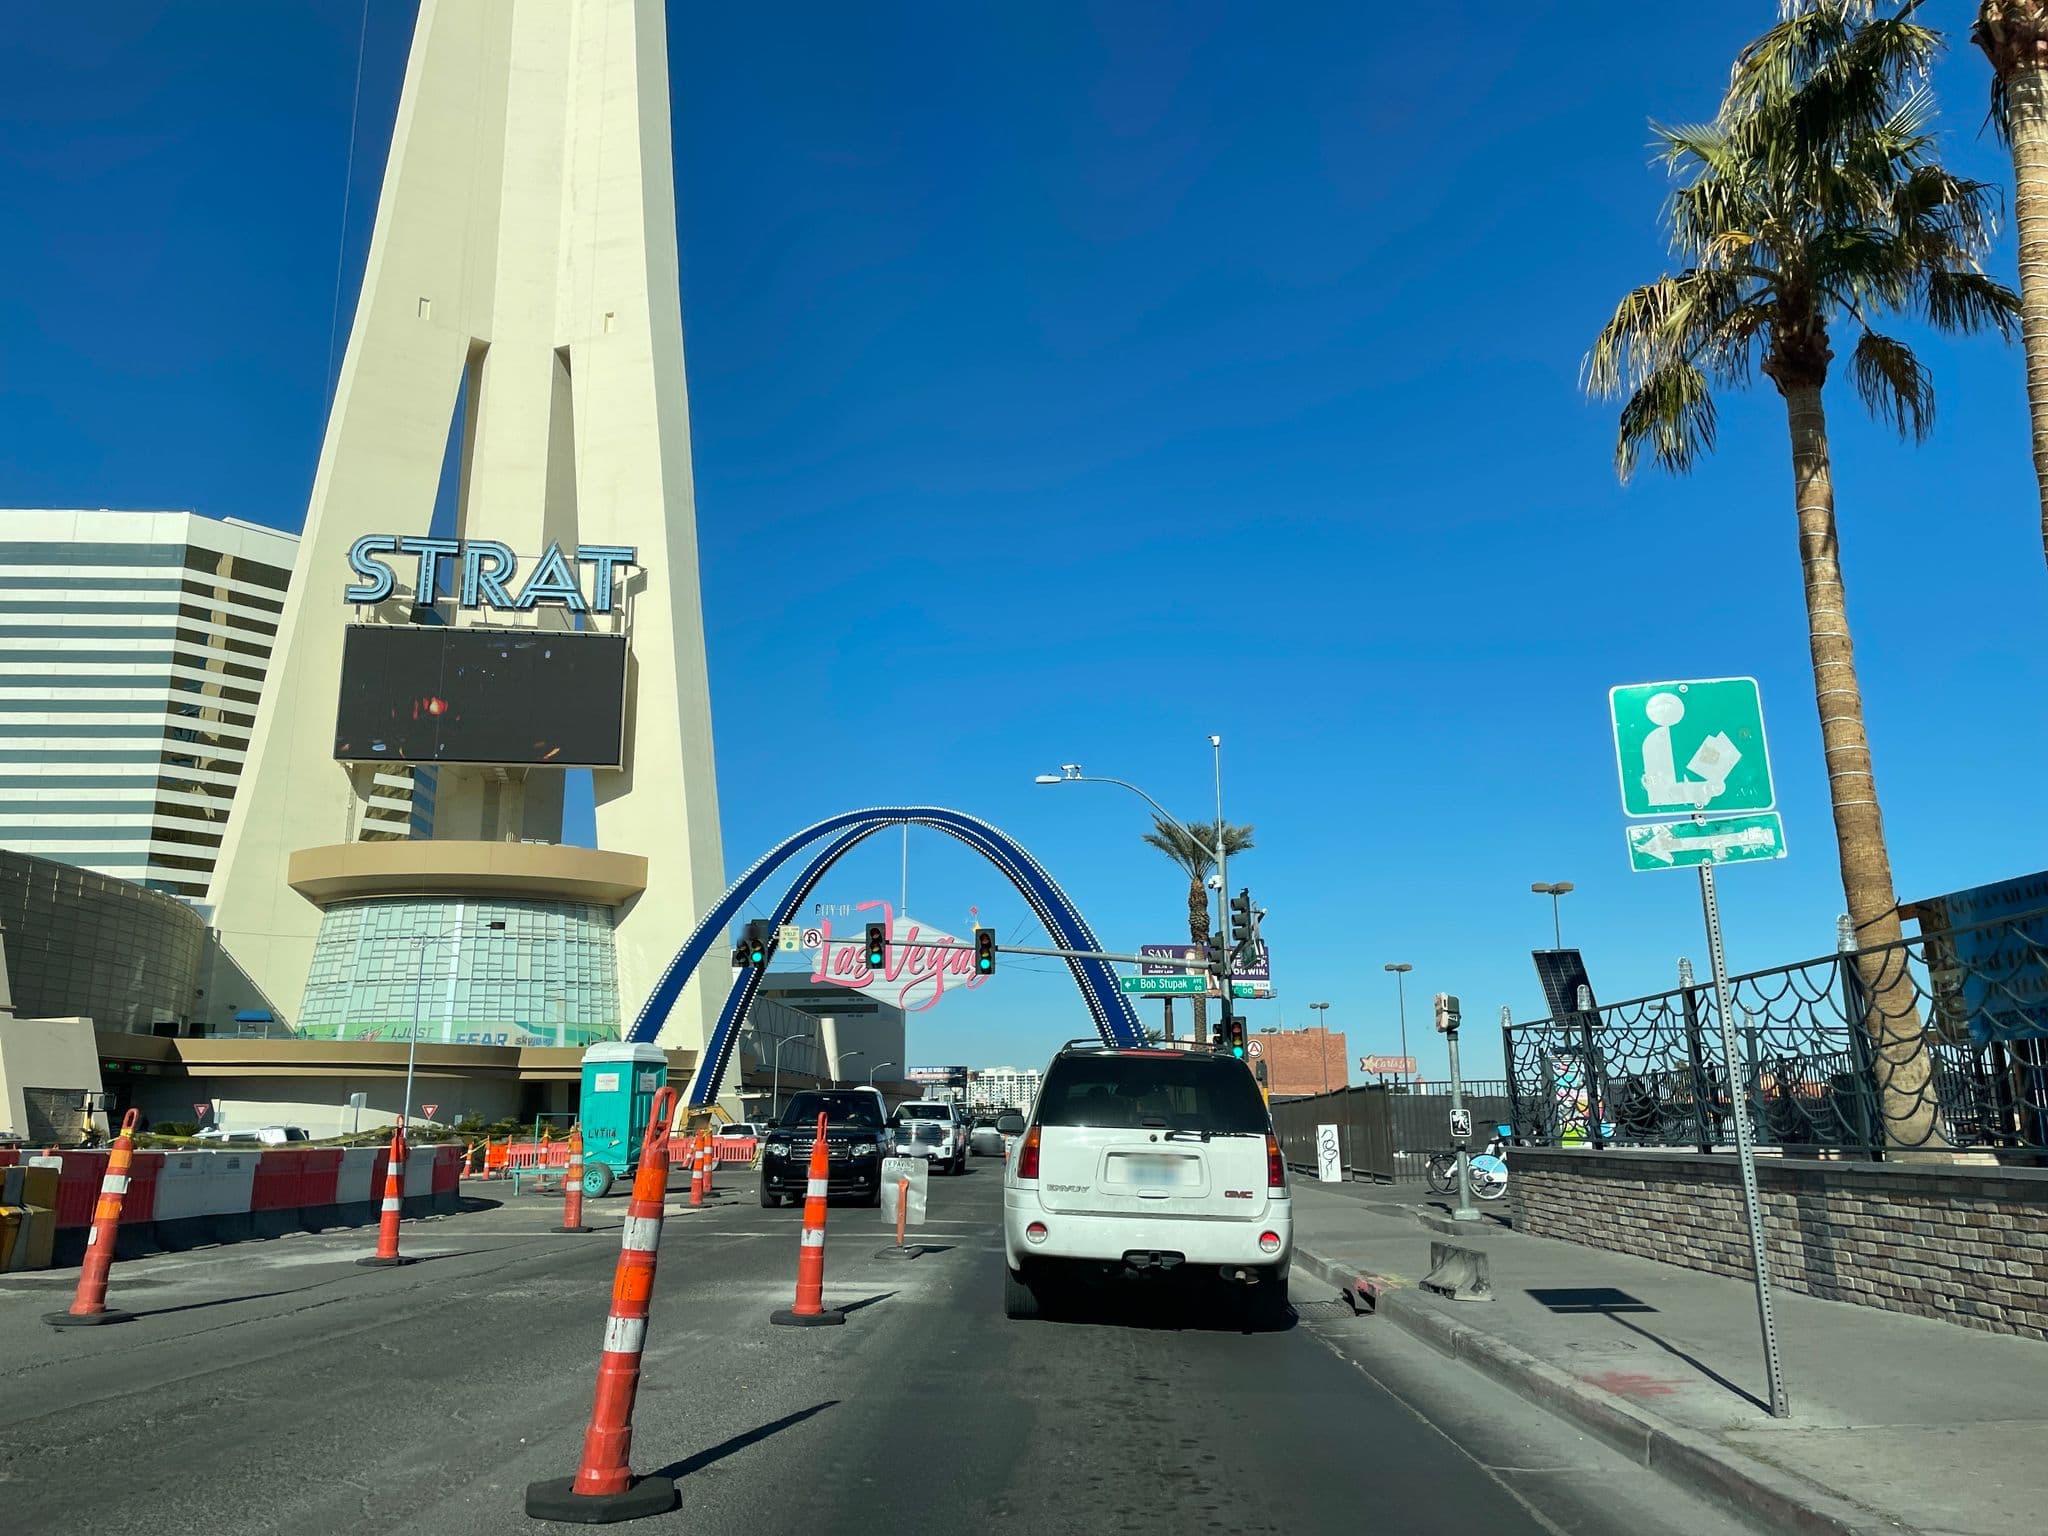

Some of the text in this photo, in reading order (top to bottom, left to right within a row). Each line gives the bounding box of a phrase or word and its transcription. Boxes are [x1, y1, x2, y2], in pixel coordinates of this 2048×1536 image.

[346, 535, 636, 613] STRAT
[1147, 949, 1173, 959] SAM
[1140, 978, 1157, 989] Bob
[1159, 978, 1188, 991] Stupak
[1224, 1190, 1254, 1200] GMC
